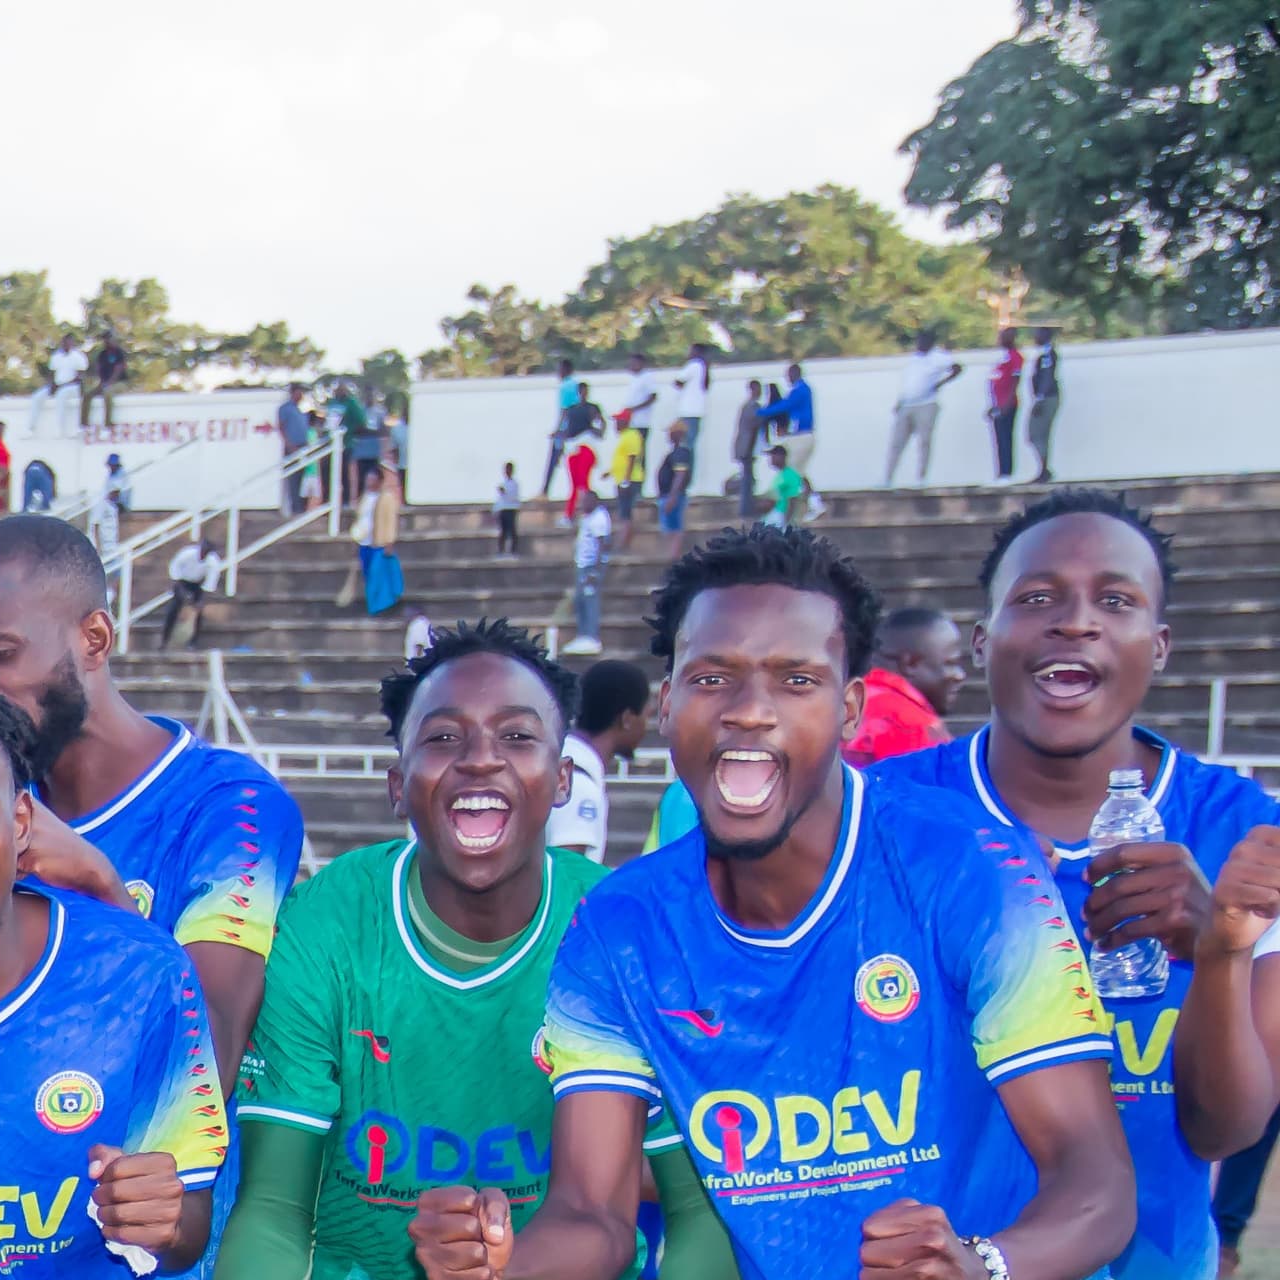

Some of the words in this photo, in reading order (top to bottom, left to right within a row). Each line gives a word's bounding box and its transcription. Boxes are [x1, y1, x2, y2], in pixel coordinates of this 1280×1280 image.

[207, 417, 248, 442] EXIT
[798, 1151, 908, 1181] Development
[911, 1144, 940, 1163] Ltd
